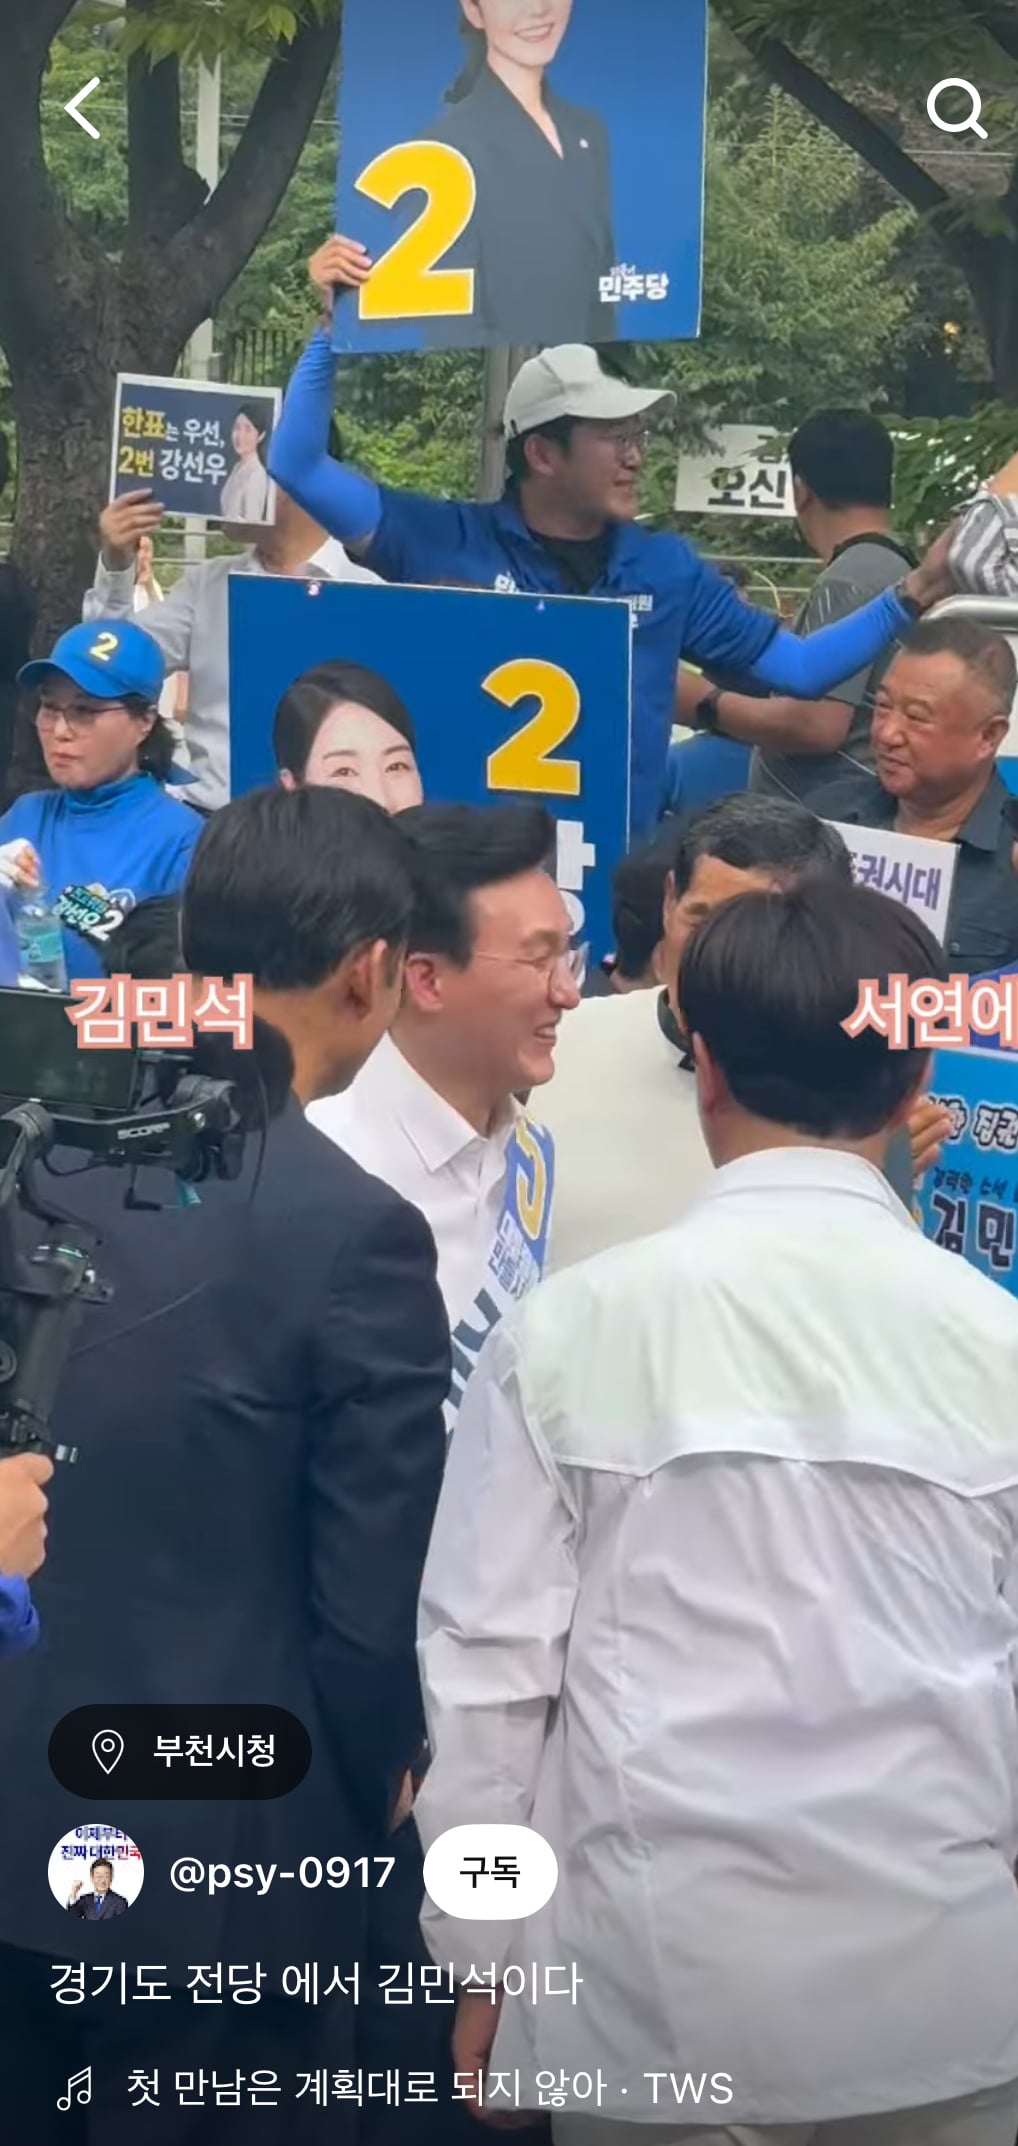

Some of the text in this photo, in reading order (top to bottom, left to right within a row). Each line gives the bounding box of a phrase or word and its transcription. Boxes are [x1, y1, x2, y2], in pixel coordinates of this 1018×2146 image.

[354, 140, 476, 320] 2
[598, 272, 670, 303] 민주당
[121, 405, 226, 448] 한표는 우선,
[118, 446, 227, 485] 2번 강선우
[89, 632, 118, 661] 2
[481, 658, 580, 795] 2
[89, 909, 124, 941] 2
